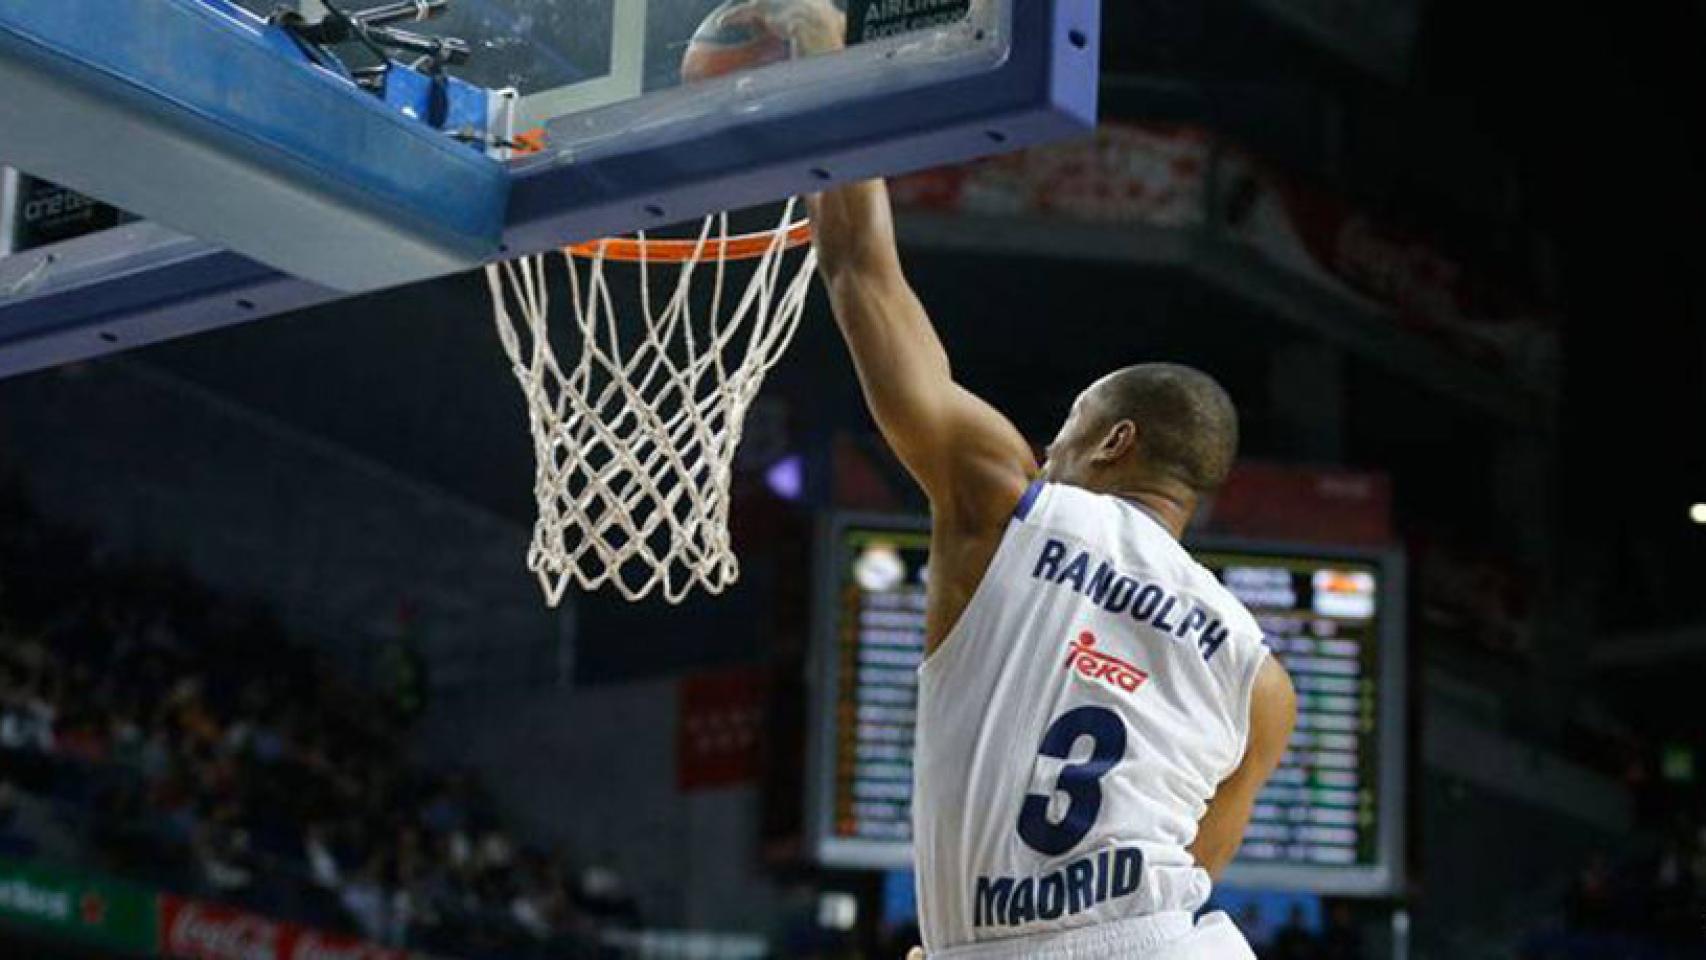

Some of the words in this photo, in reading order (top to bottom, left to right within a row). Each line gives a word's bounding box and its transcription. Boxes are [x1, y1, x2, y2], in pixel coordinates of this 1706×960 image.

[1032, 538, 1230, 662] RANDOLPH
[1016, 706, 1127, 856] 3
[974, 846, 1144, 927] MADRID
